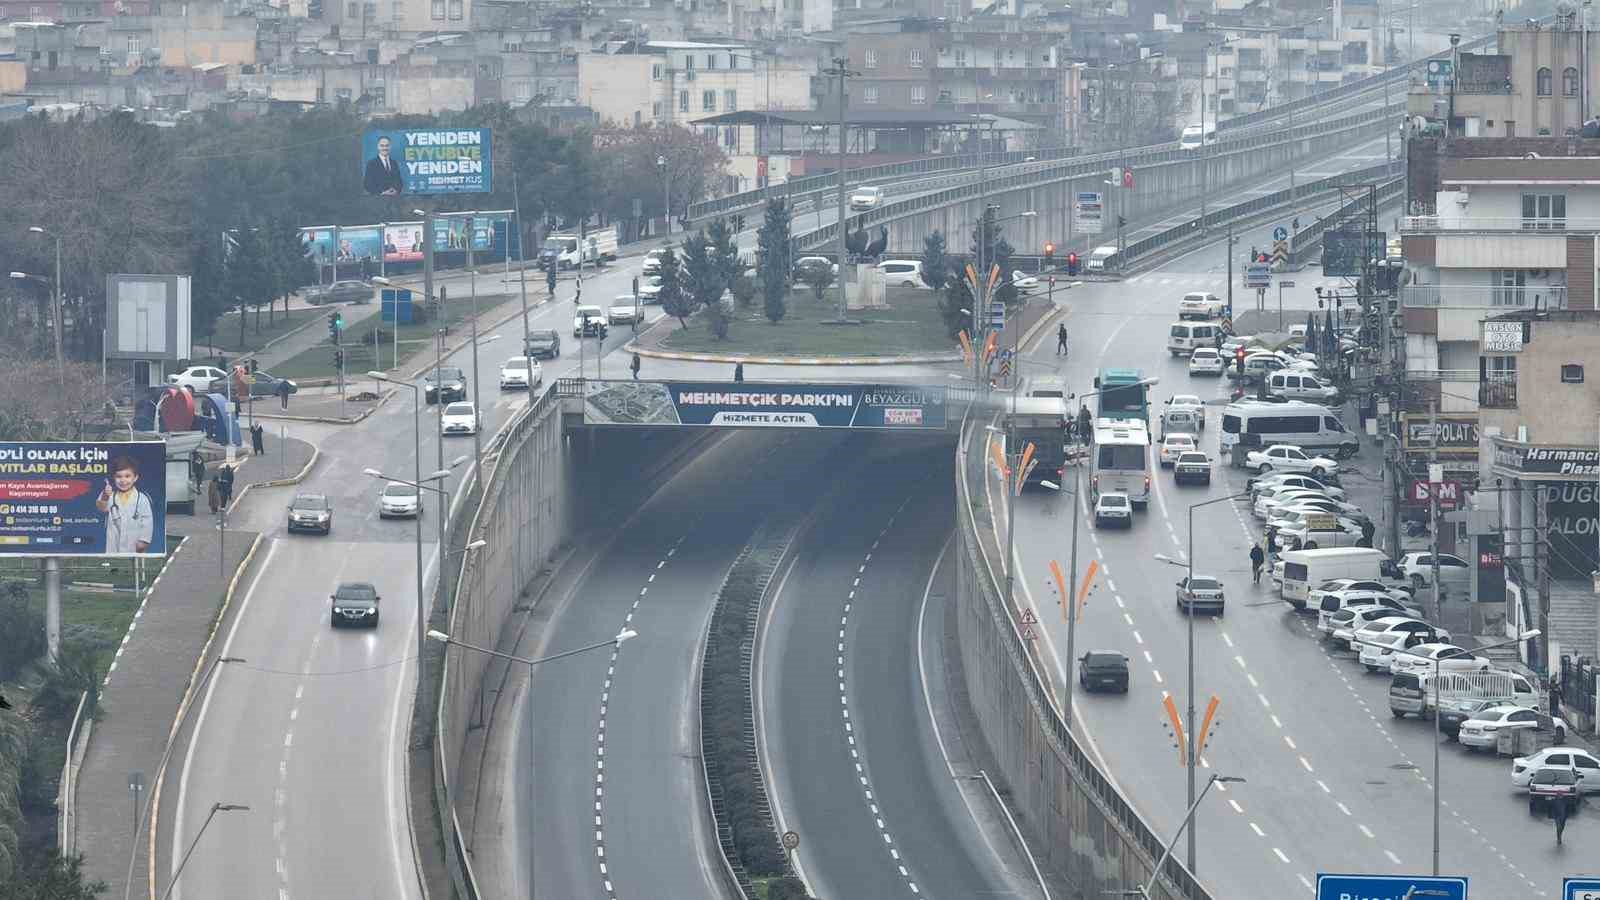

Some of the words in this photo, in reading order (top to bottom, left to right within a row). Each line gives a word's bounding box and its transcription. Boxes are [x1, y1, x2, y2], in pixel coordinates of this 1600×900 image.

[781, 394, 852, 407] PARKI'NI
[1436, 424, 1470, 441] POLAT
[27, 450, 77, 460] OLMAK
[80, 447, 108, 463] İÇİN
[50, 463, 108, 476] BAŞLADI
[1416, 482, 1457, 499] BM
